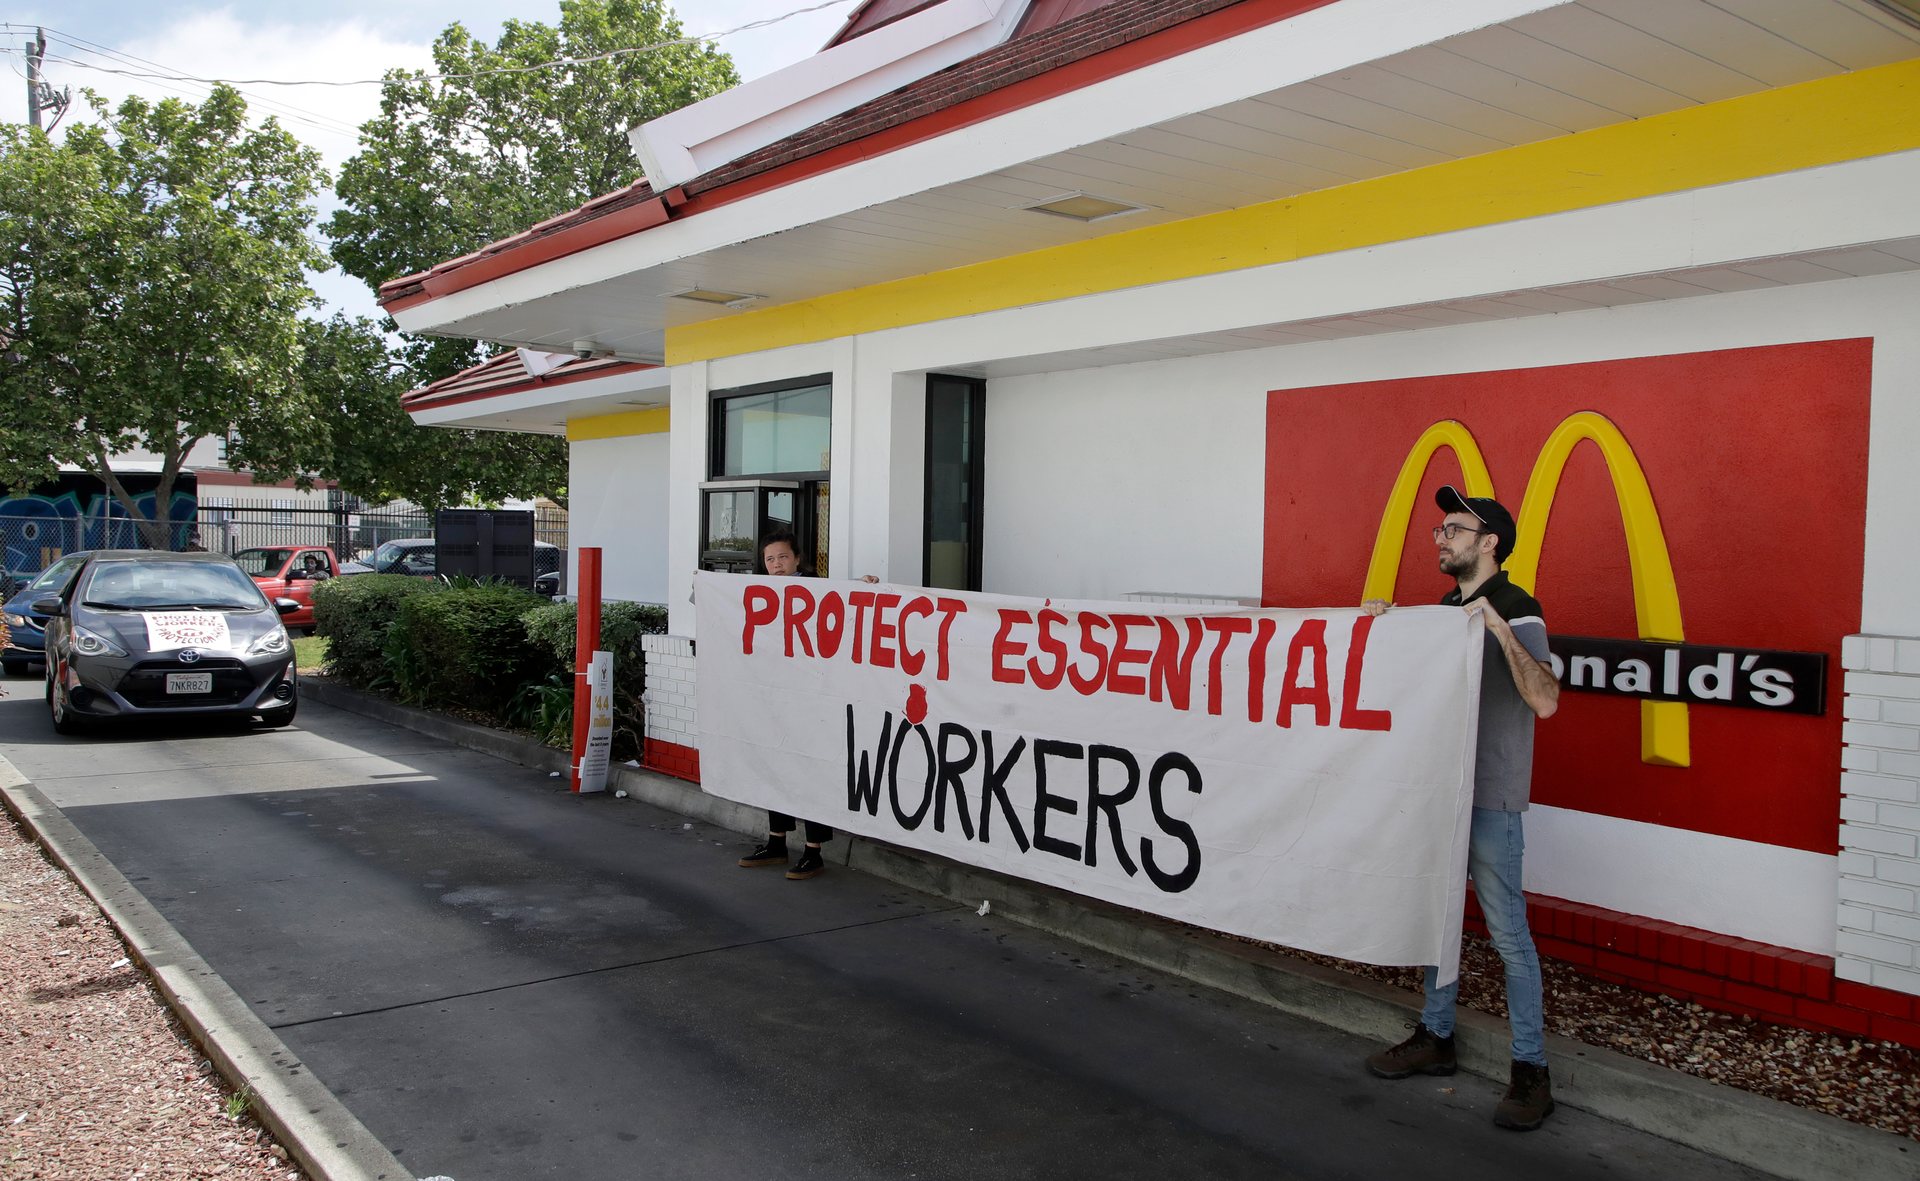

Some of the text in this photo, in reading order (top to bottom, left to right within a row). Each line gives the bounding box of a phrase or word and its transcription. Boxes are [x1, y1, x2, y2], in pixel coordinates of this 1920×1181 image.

[170, 681, 209, 691] 7NKR827
[742, 584, 1391, 731] PROTECT ESSENTIAL
[594, 695, 609, 711] $4.4
[846, 703, 1202, 893] WORKERS
